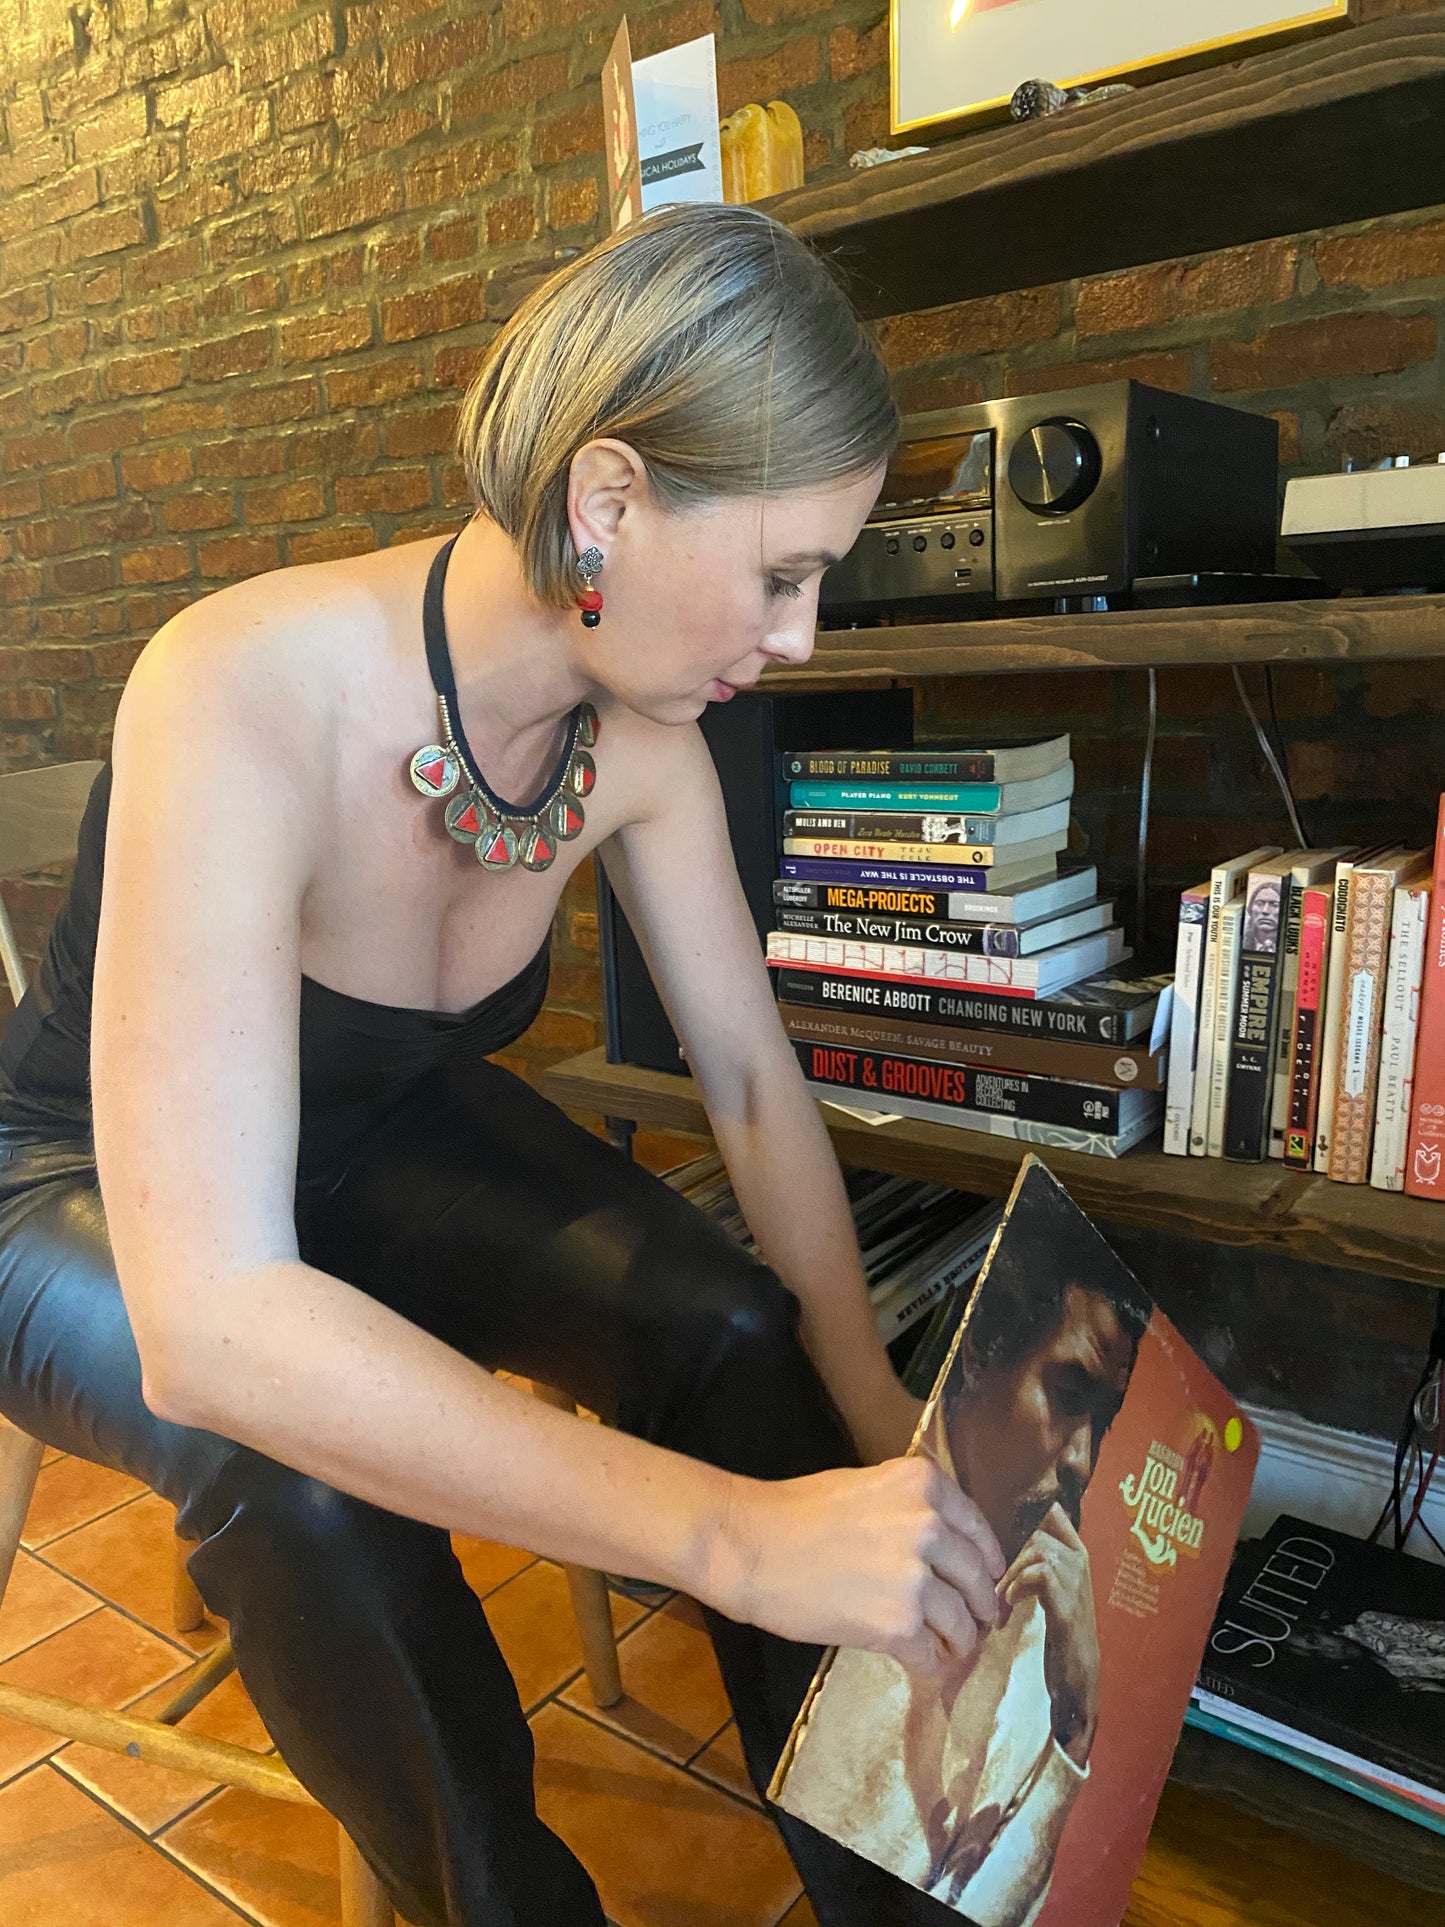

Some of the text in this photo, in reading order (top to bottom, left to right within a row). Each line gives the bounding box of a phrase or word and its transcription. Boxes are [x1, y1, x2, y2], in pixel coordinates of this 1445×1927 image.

[662, 153, 697, 172] HOLIDAYS
[809, 760, 834, 774] BLOOD
[837, 761, 847, 774] OF
[850, 760, 890, 775] PARADISE
[900, 763, 958, 774] DAVID CORBETT
[841, 791, 891, 800] PLAYER PIANO
[814, 843, 885, 858] OPEN CITY
[861, 870, 879, 879] WAY
[881, 871, 898, 880] THE
[900, 872, 908, 880] IS
[910, 873, 955, 884] OBSTACLE
[958, 876, 975, 884] THE
[1214, 881, 1222, 896] THIS
[828, 888, 935, 914] MEGA-PROJECTS
[964, 904, 998, 913] BROOKINGS
[782, 913, 814, 922] MICHELLE
[1212, 905, 1220, 921] OUR
[1286, 886, 1303, 955] BLACK LOOKS
[783, 920, 818, 929] ALEXANDER
[824, 914, 972, 945] The New Jim Crow
[1210, 922, 1218, 942] YOUTH
[1395, 921, 1410, 1011] THE SELLOUT
[822, 981, 931, 1013] BERENICE ABBOTT
[1247, 965, 1271, 1040] EMPIRE
[938, 998, 1007, 1023] CHANGING
[1012, 1007, 1043, 1027] NEW
[1047, 1011, 1087, 1034] YORK
[1238, 981, 1251, 1038] SUMMER MOON
[788, 1019, 848, 1035] ALEXANDER
[906, 1035, 946, 1049] SAVAGE
[949, 1041, 993, 1056] BEAUTY
[813, 1048, 966, 1103] DUST & GROOVES
[1291, 1015, 1306, 1122] FIDELITY
[1302, 1043, 1311, 1097] HIGH
[976, 1074, 1029, 1093] ADVENTURES IN
[1385, 1037, 1400, 1122] PAUL BEATTY
[976, 1085, 1003, 1099] RECORD
[976, 1094, 1016, 1112] COLLECTING
[1119, 1456, 1177, 1506] Jon
[1130, 1493, 1204, 1566] Lucien
[1211, 1537, 1335, 1668] SUITED
